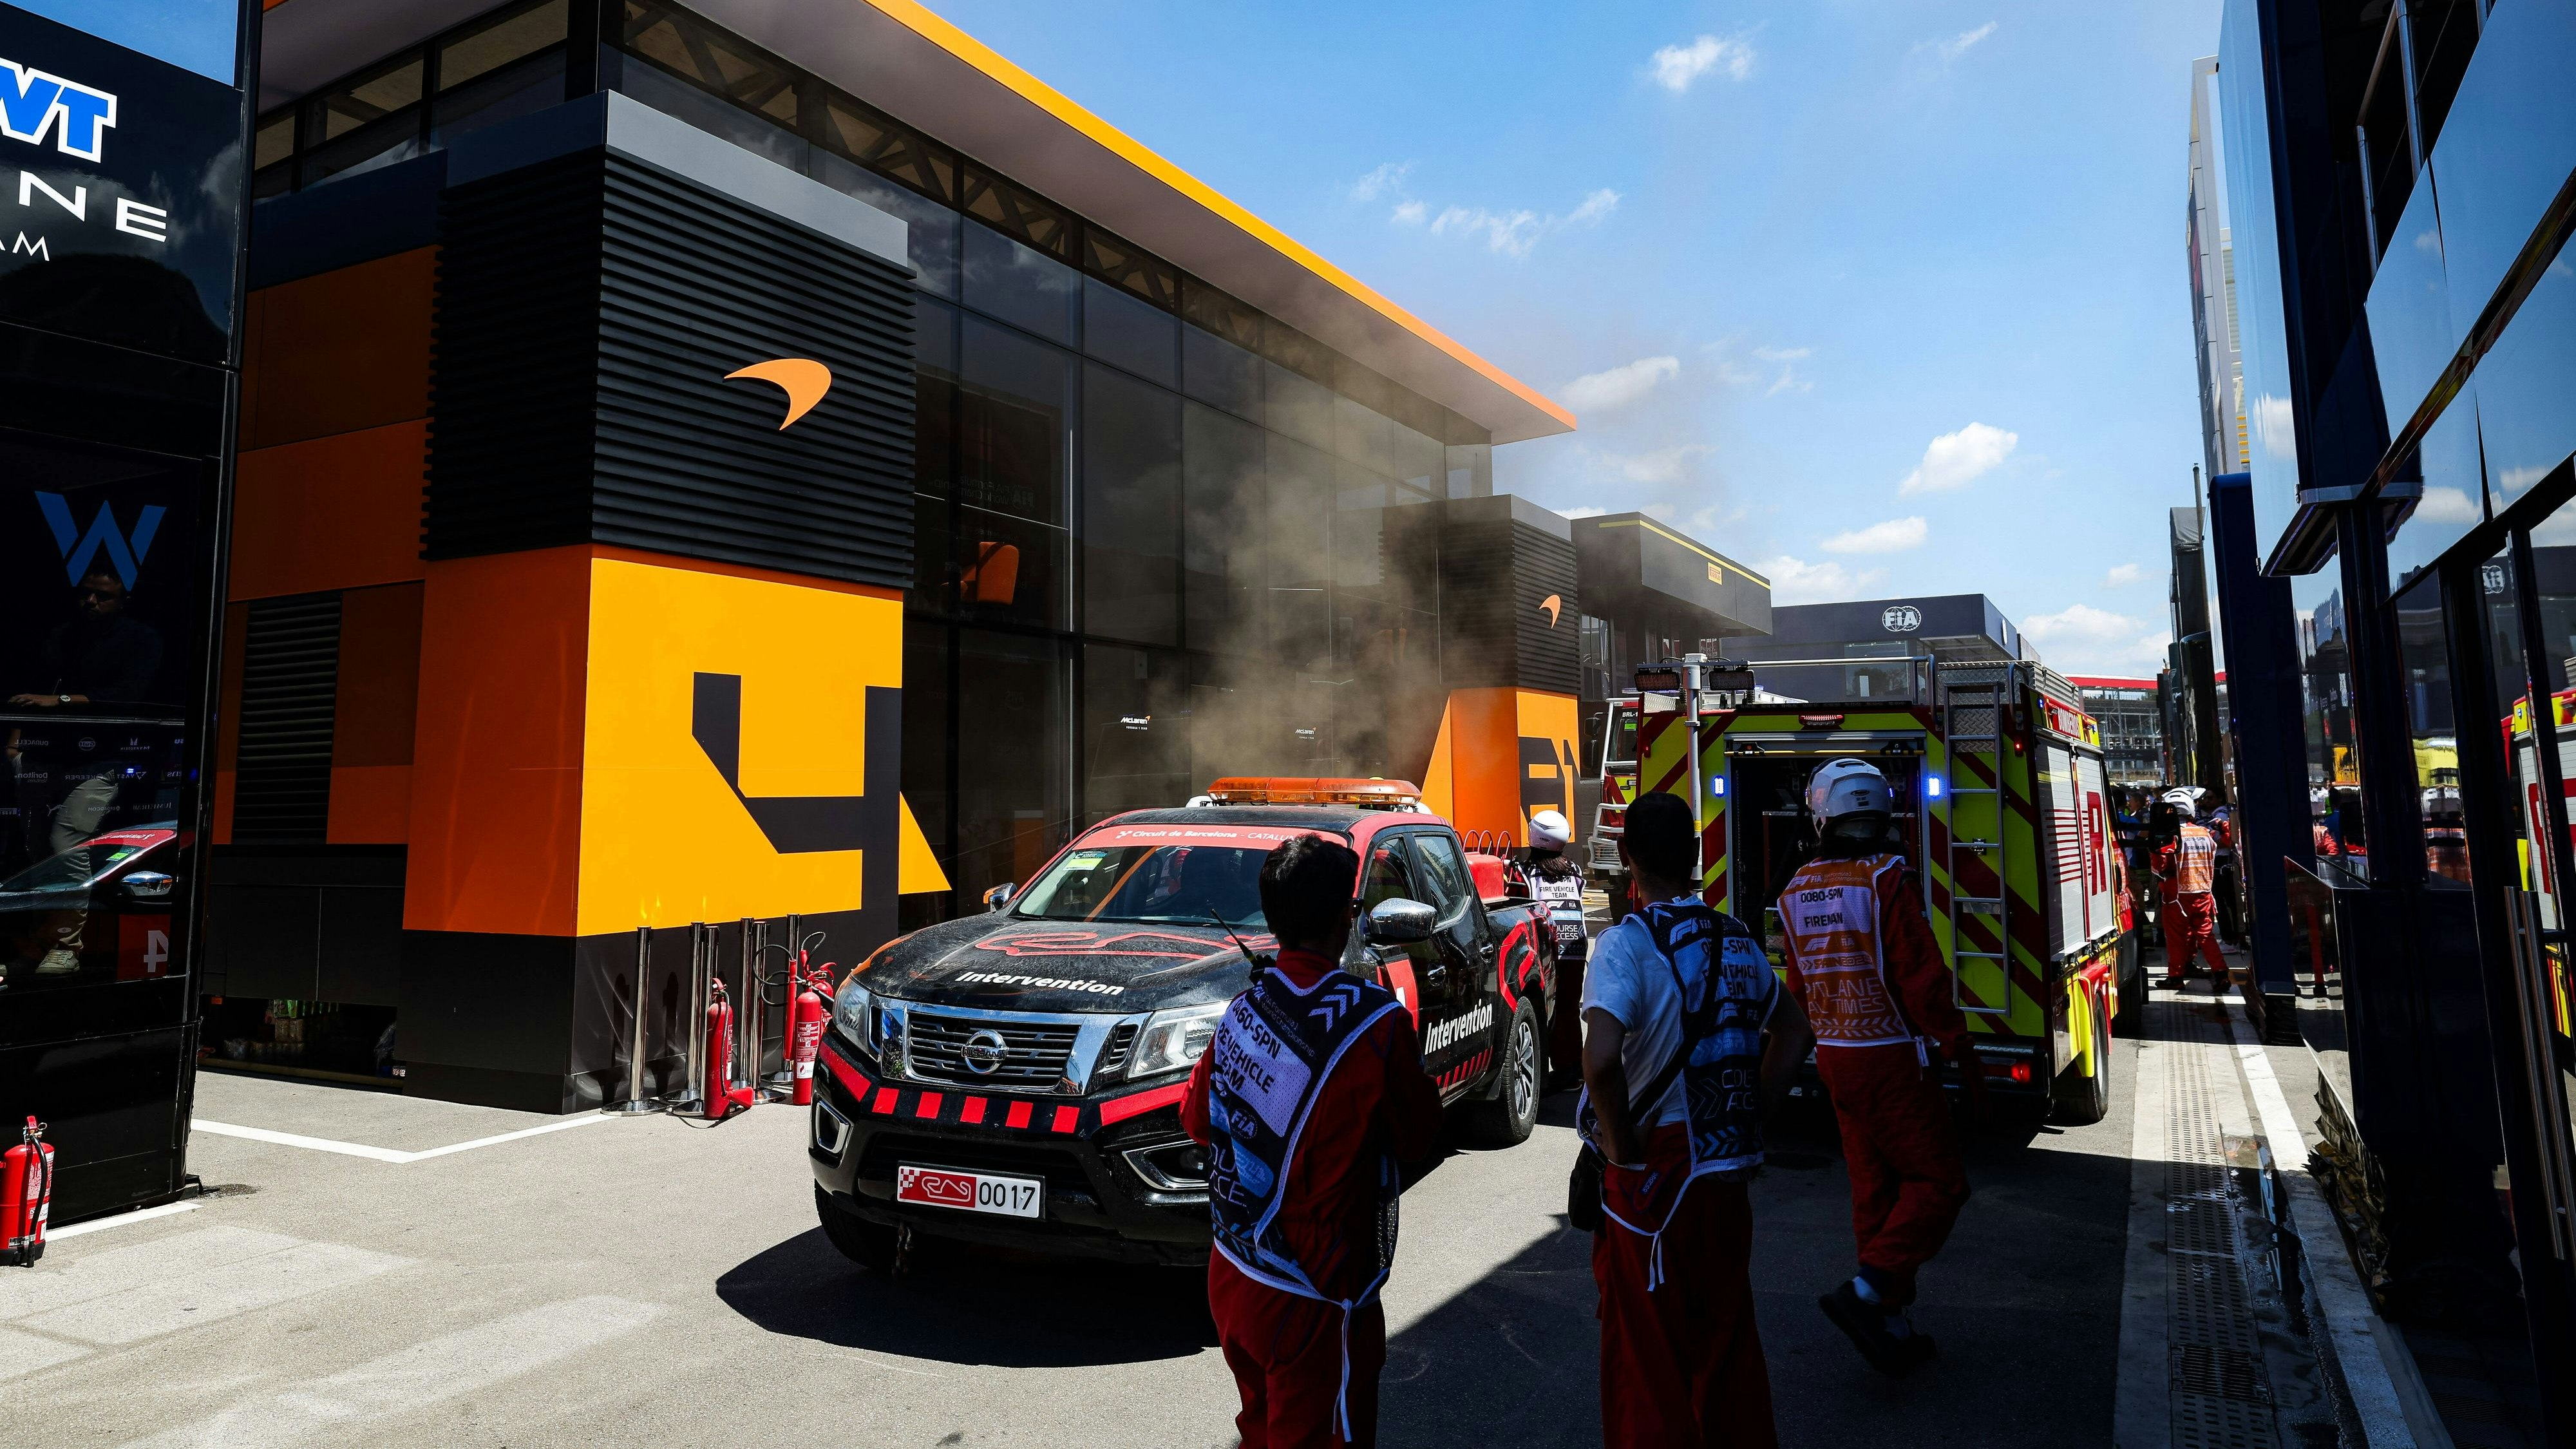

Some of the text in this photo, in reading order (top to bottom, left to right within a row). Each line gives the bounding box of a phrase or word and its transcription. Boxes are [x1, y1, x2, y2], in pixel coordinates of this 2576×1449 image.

[0, 231, 50, 261] M
[1884, 611, 1919, 628] FIA
[1804, 912, 1843, 928] FIREMAN
[954, 970, 1126, 996] Intervention
[1830, 996, 1886, 1014] TIMES
[1425, 998, 1493, 1056] Intervention
[963, 1046, 1007, 1060] NISSAN
[1227, 1035, 1274, 1095] VEHICLE
[978, 1182, 1037, 1211] 0017
